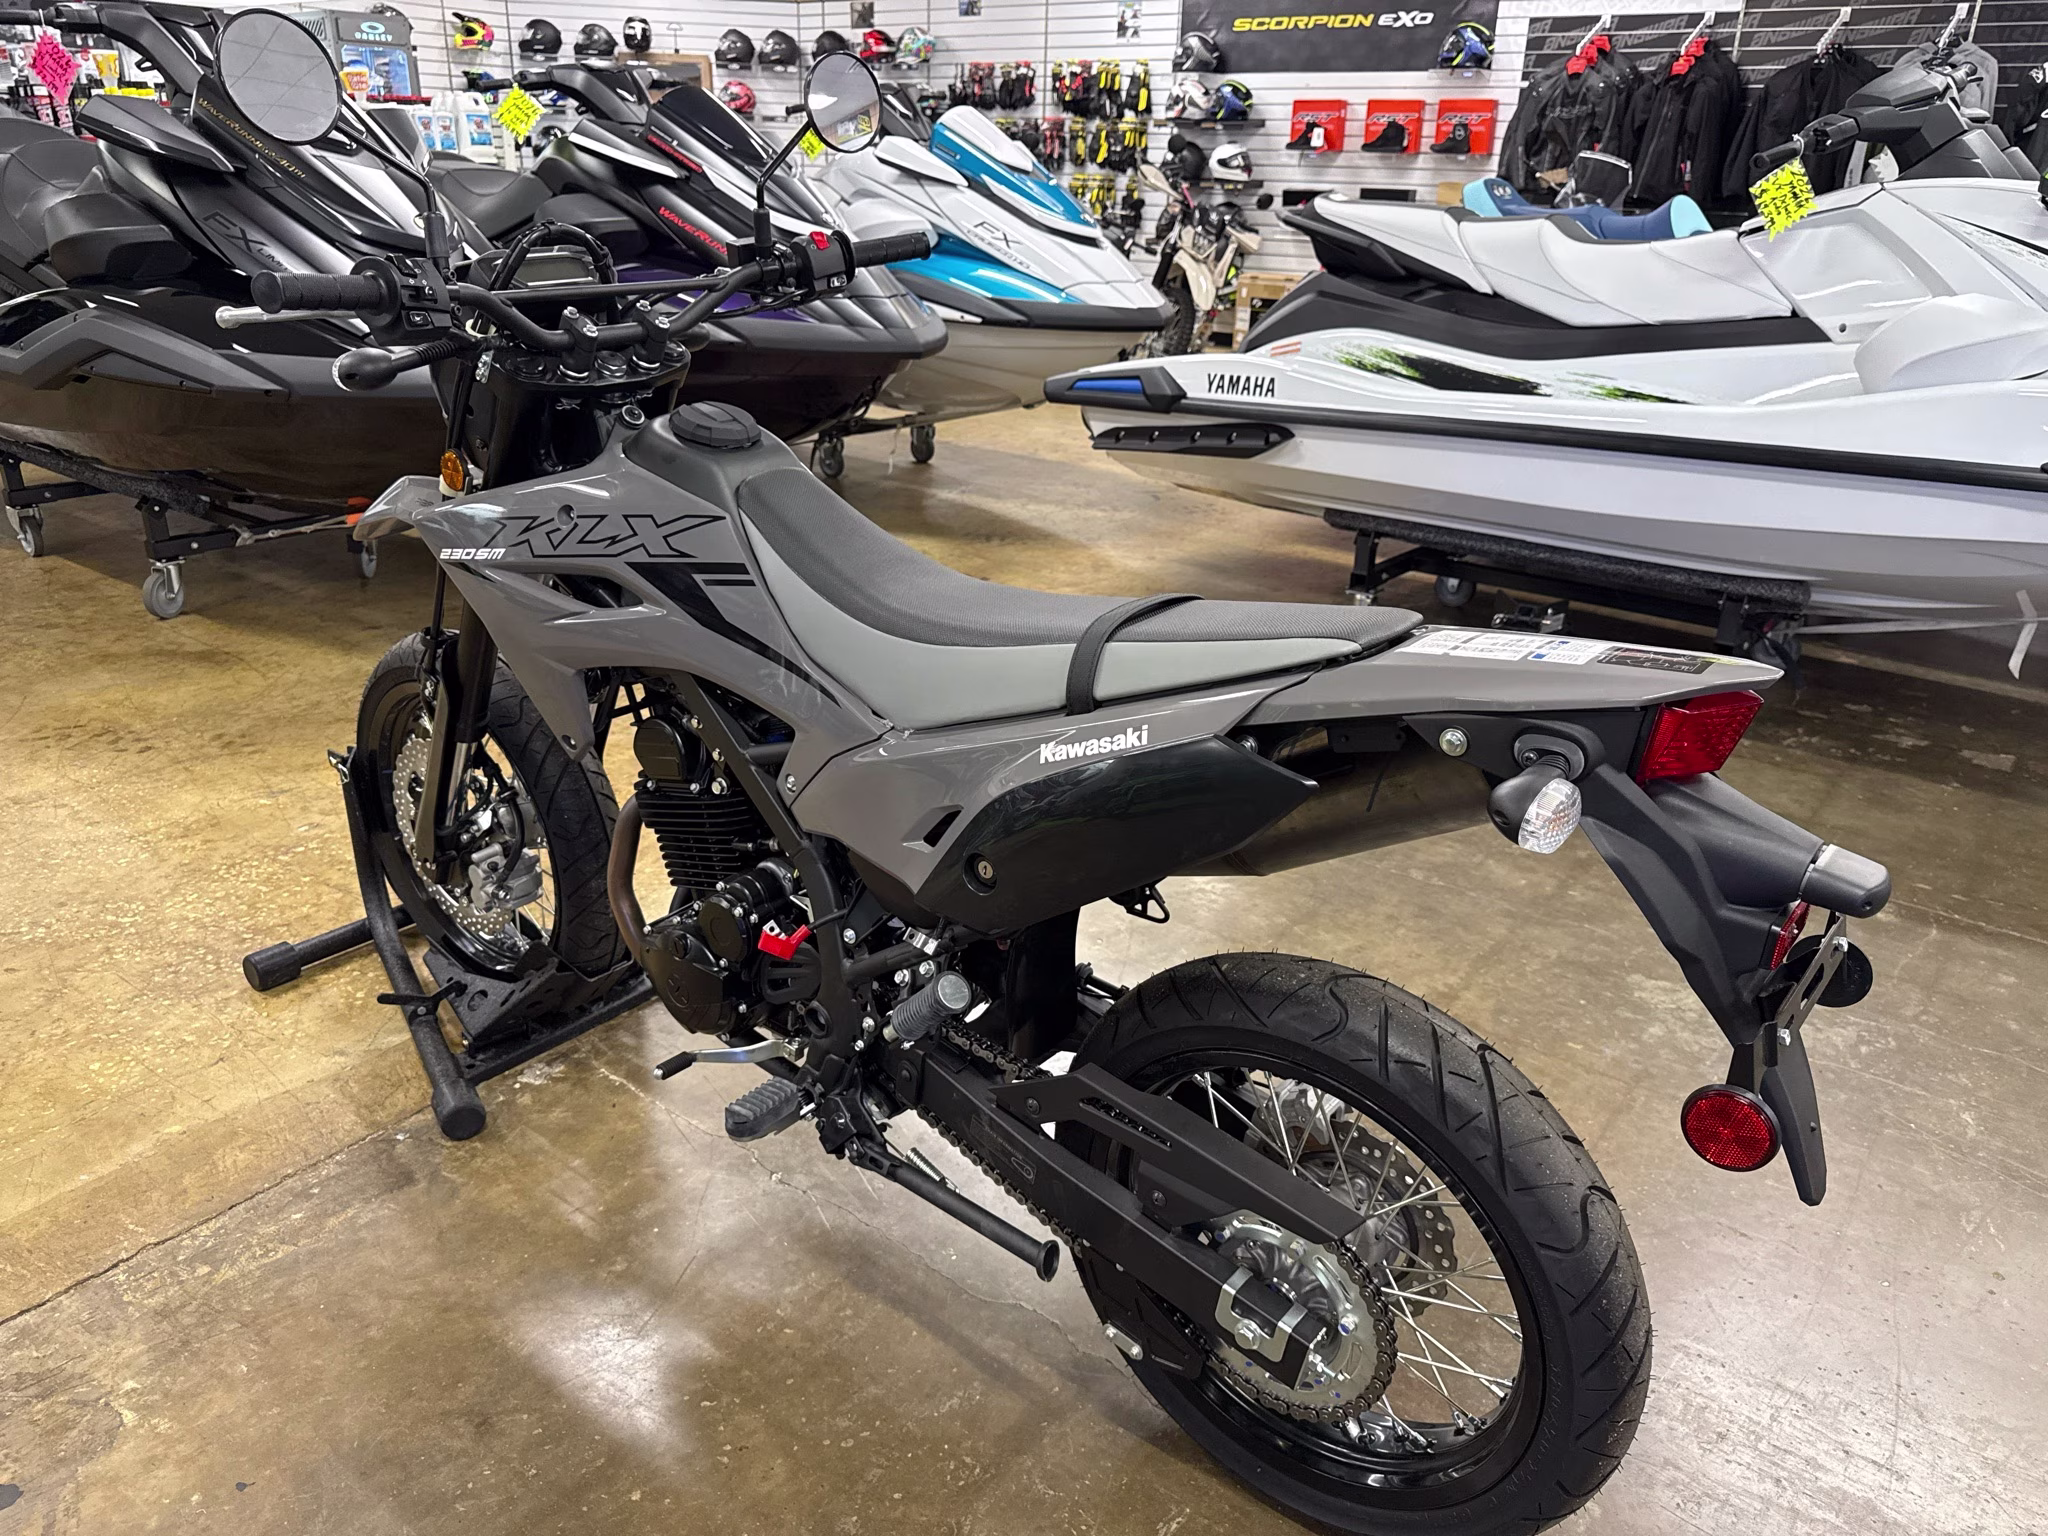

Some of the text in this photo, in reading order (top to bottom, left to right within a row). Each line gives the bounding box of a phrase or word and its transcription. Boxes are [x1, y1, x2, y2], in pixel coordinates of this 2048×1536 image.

[1232, 14, 1375, 32] SCORPION
[354, 31, 393, 42] OAKLEY
[1293, 111, 1340, 124] RST
[1366, 112, 1420, 124] RST
[1438, 112, 1492, 124] RST
[203, 211, 270, 253] FX
[973, 221, 1023, 250] FX
[1207, 373, 1275, 398] YAMAHA
[485, 514, 727, 559] KLX
[440, 547, 506, 560] 230SM
[1039, 724, 1149, 764] Kawasaki
